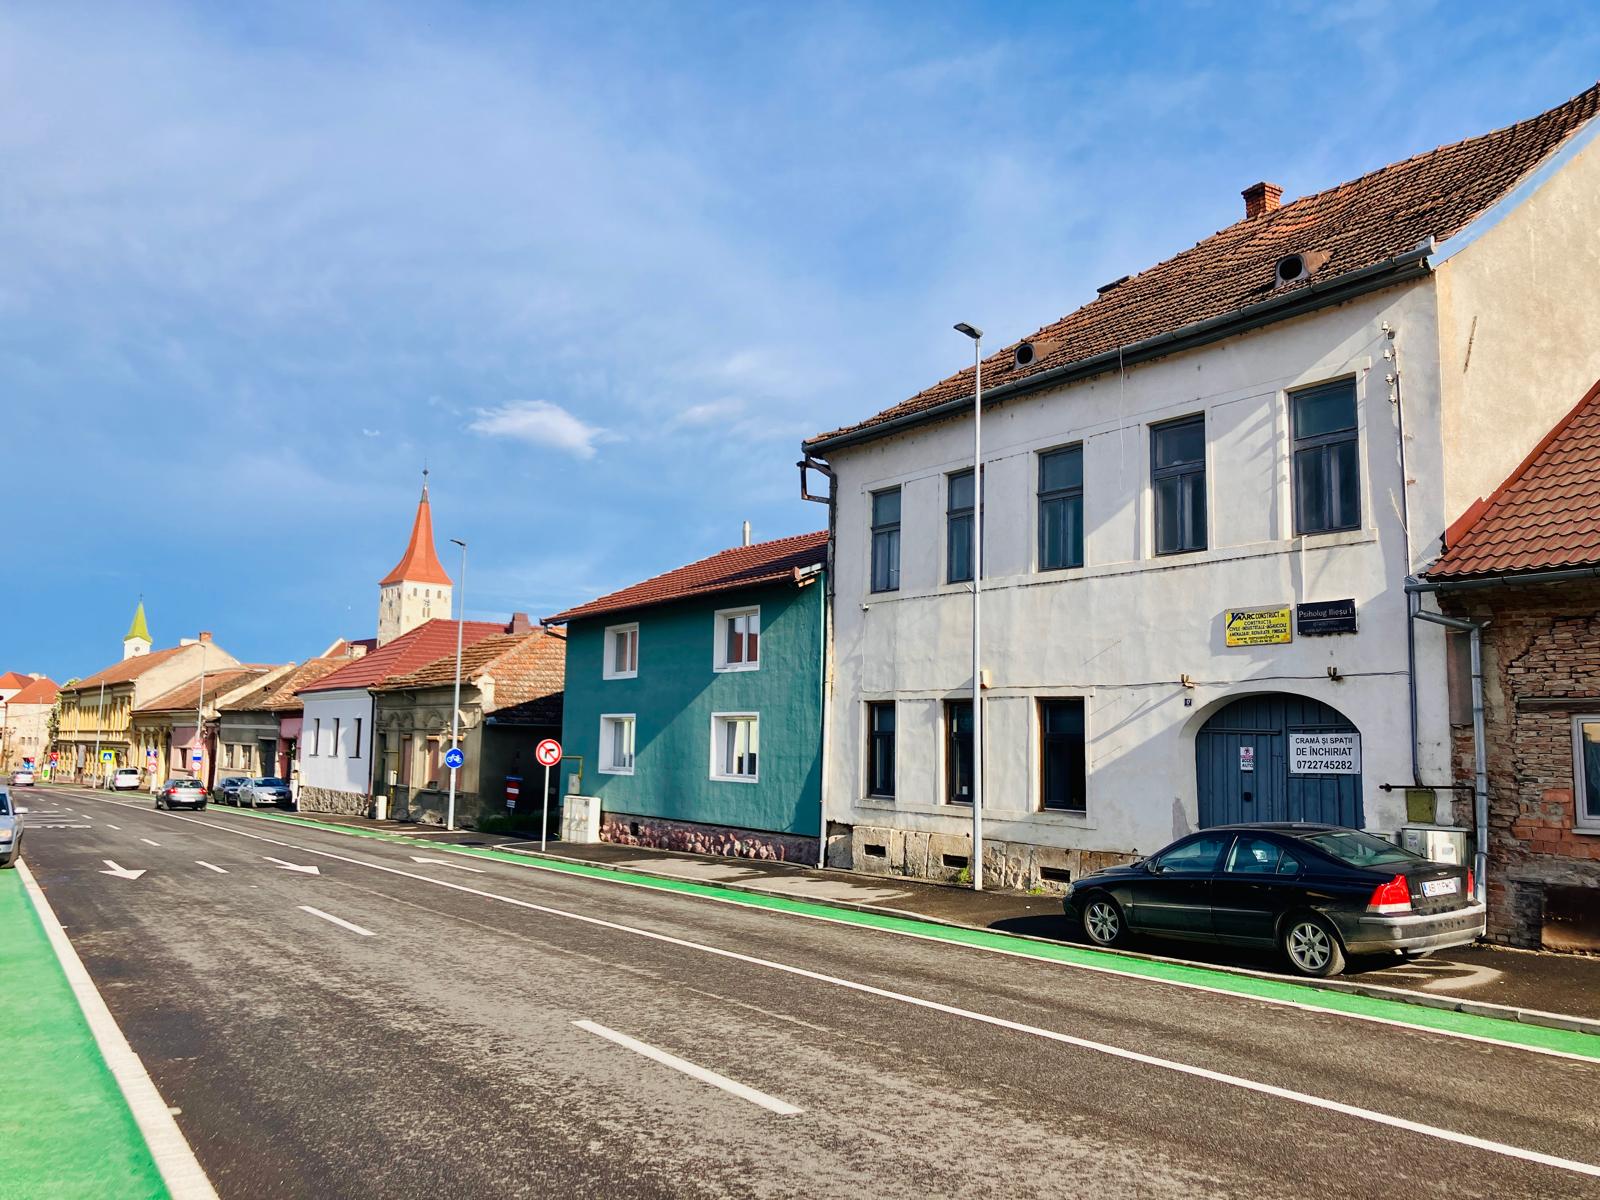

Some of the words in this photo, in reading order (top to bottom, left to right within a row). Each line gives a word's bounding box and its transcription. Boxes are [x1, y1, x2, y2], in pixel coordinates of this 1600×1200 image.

[1298, 609, 1328, 618] Psiholog
[1295, 736, 1320, 744] CRAMĂ
[1329, 736, 1353, 745] SPAȚII
[1296, 747, 1307, 756] DE
[1309, 745, 1353, 756] ÎNCHIRIAT
[1296, 760, 1353, 770] 0722745282
